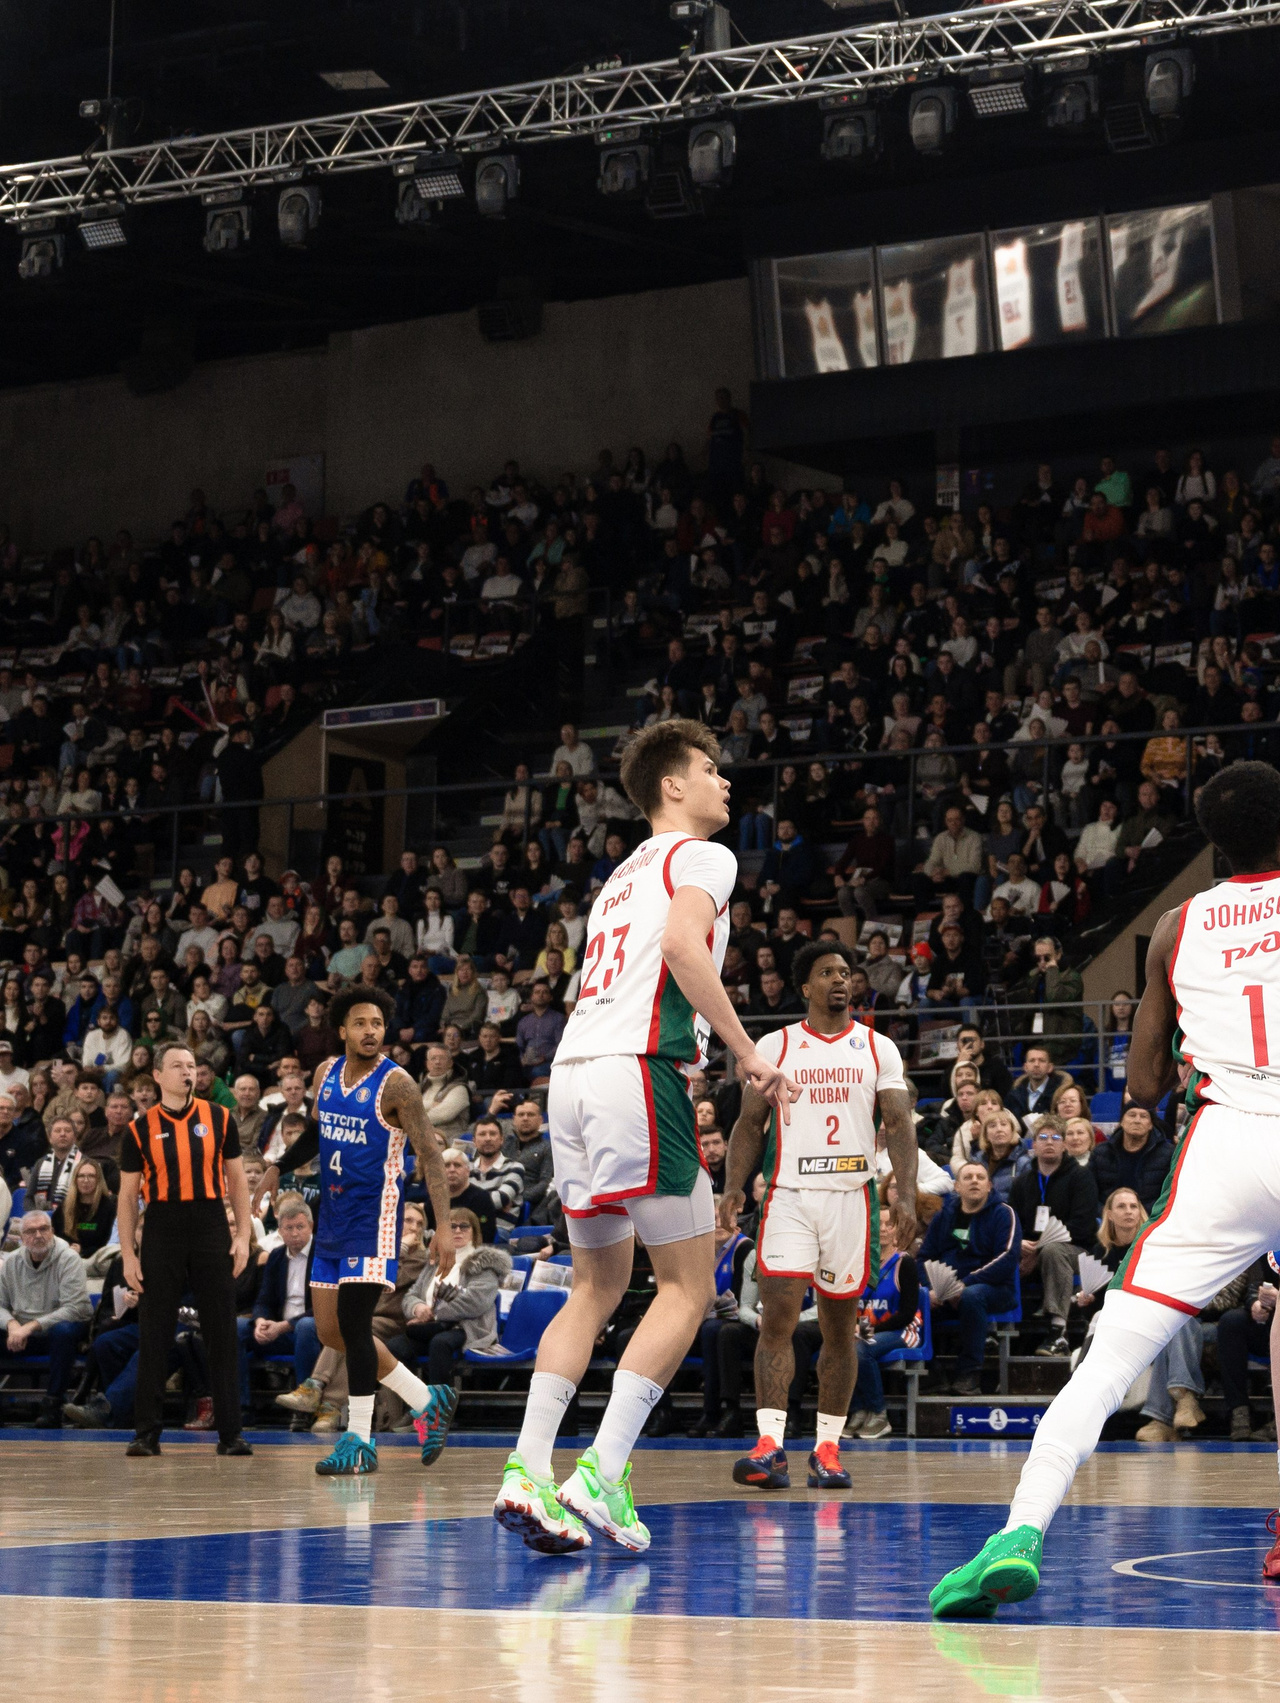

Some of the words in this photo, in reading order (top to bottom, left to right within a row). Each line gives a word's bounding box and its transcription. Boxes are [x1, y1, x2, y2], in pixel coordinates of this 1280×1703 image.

[578, 923, 631, 1001] 23
[1242, 985, 1269, 1068] 1
[794, 1067, 864, 1085] LOKOMOTIV
[809, 1087, 850, 1104] KUBAN
[826, 1115, 841, 1146] 2
[329, 1150, 342, 1176] 4
[956, 1414, 964, 1425] 5
[995, 1411, 1002, 1422] 1
[1033, 1414, 1041, 1425] 6
